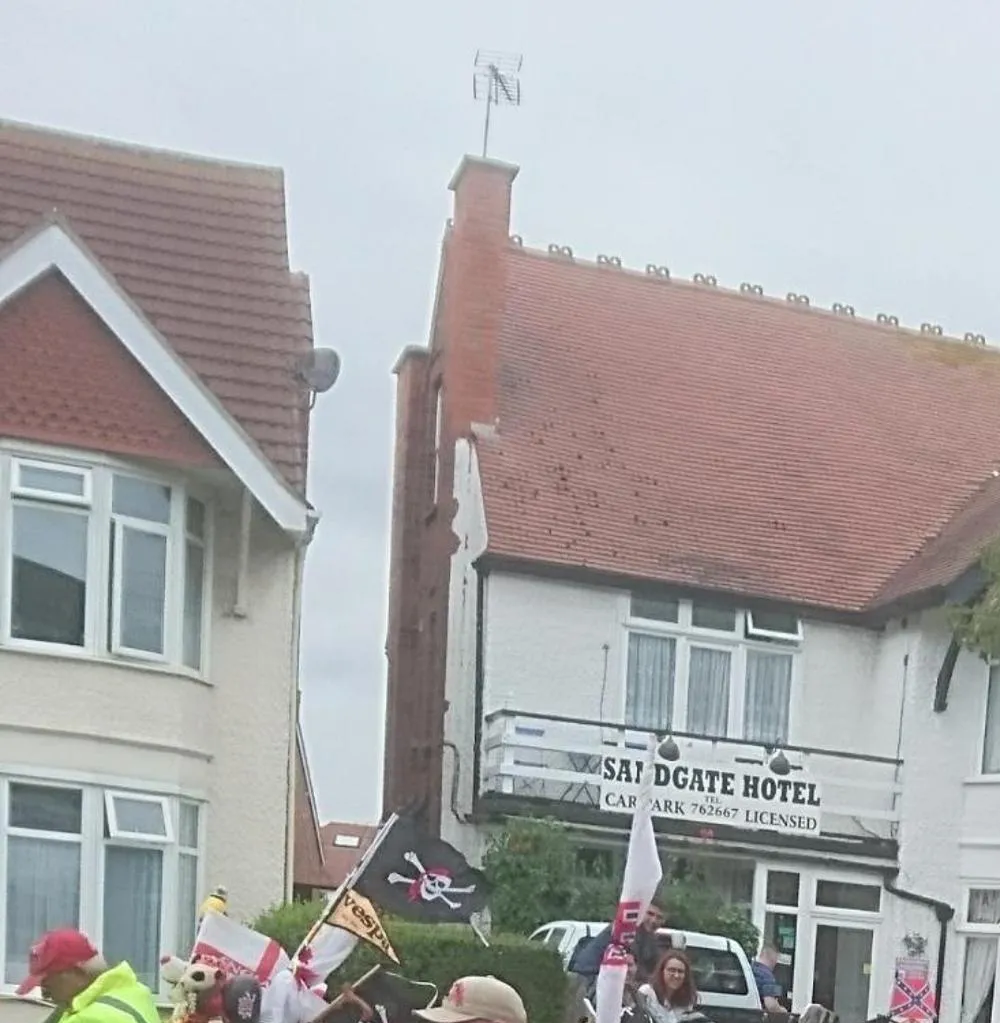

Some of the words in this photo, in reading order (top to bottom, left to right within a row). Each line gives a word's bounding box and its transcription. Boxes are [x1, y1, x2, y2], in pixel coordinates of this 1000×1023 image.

[741, 775, 822, 806] HOTEL
[605, 792, 637, 809] CAR
[648, 798, 685, 815] ARK
[691, 803, 739, 818] 762667
[745, 810, 818, 831] LICENSED
